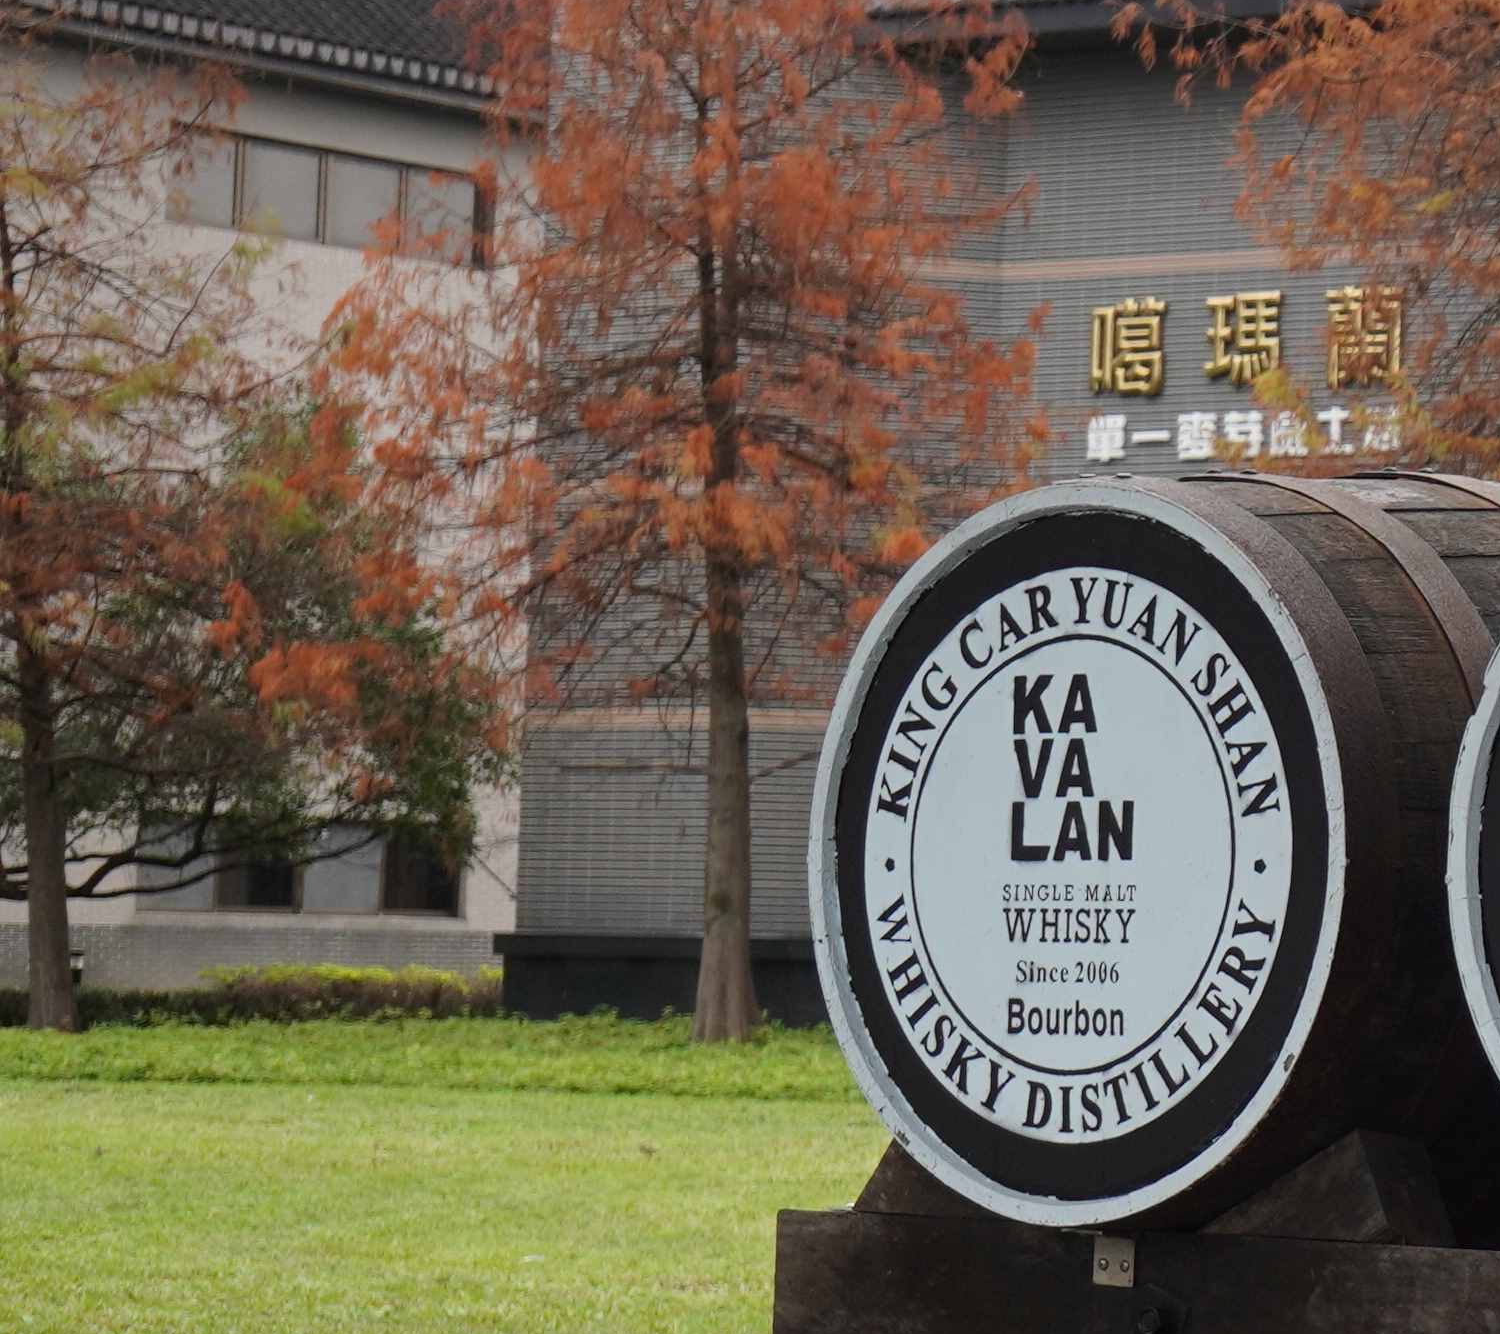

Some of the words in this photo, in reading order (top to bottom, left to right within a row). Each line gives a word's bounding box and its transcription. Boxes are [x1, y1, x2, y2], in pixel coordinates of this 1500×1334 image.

[876, 662, 957, 822] KING
[960, 585, 1059, 669] CAR
[1070, 578, 1202, 666] YUAN
[1190, 653, 1280, 817] SHAN
[1013, 674, 1097, 735] KA
[1014, 738, 1094, 798] VA
[1011, 801, 1134, 862] LAN
[1003, 885, 1073, 902] SINGLE
[1086, 885, 1136, 902] MALT
[1003, 908, 1135, 944] WHISKY
[1016, 961, 1066, 983] Since
[1076, 962, 1119, 983] 2006
[877, 894, 1015, 1113] WHISKY
[1022, 899, 1275, 1133] DISTILLERY
[1008, 998, 1123, 1036] Bourbon
